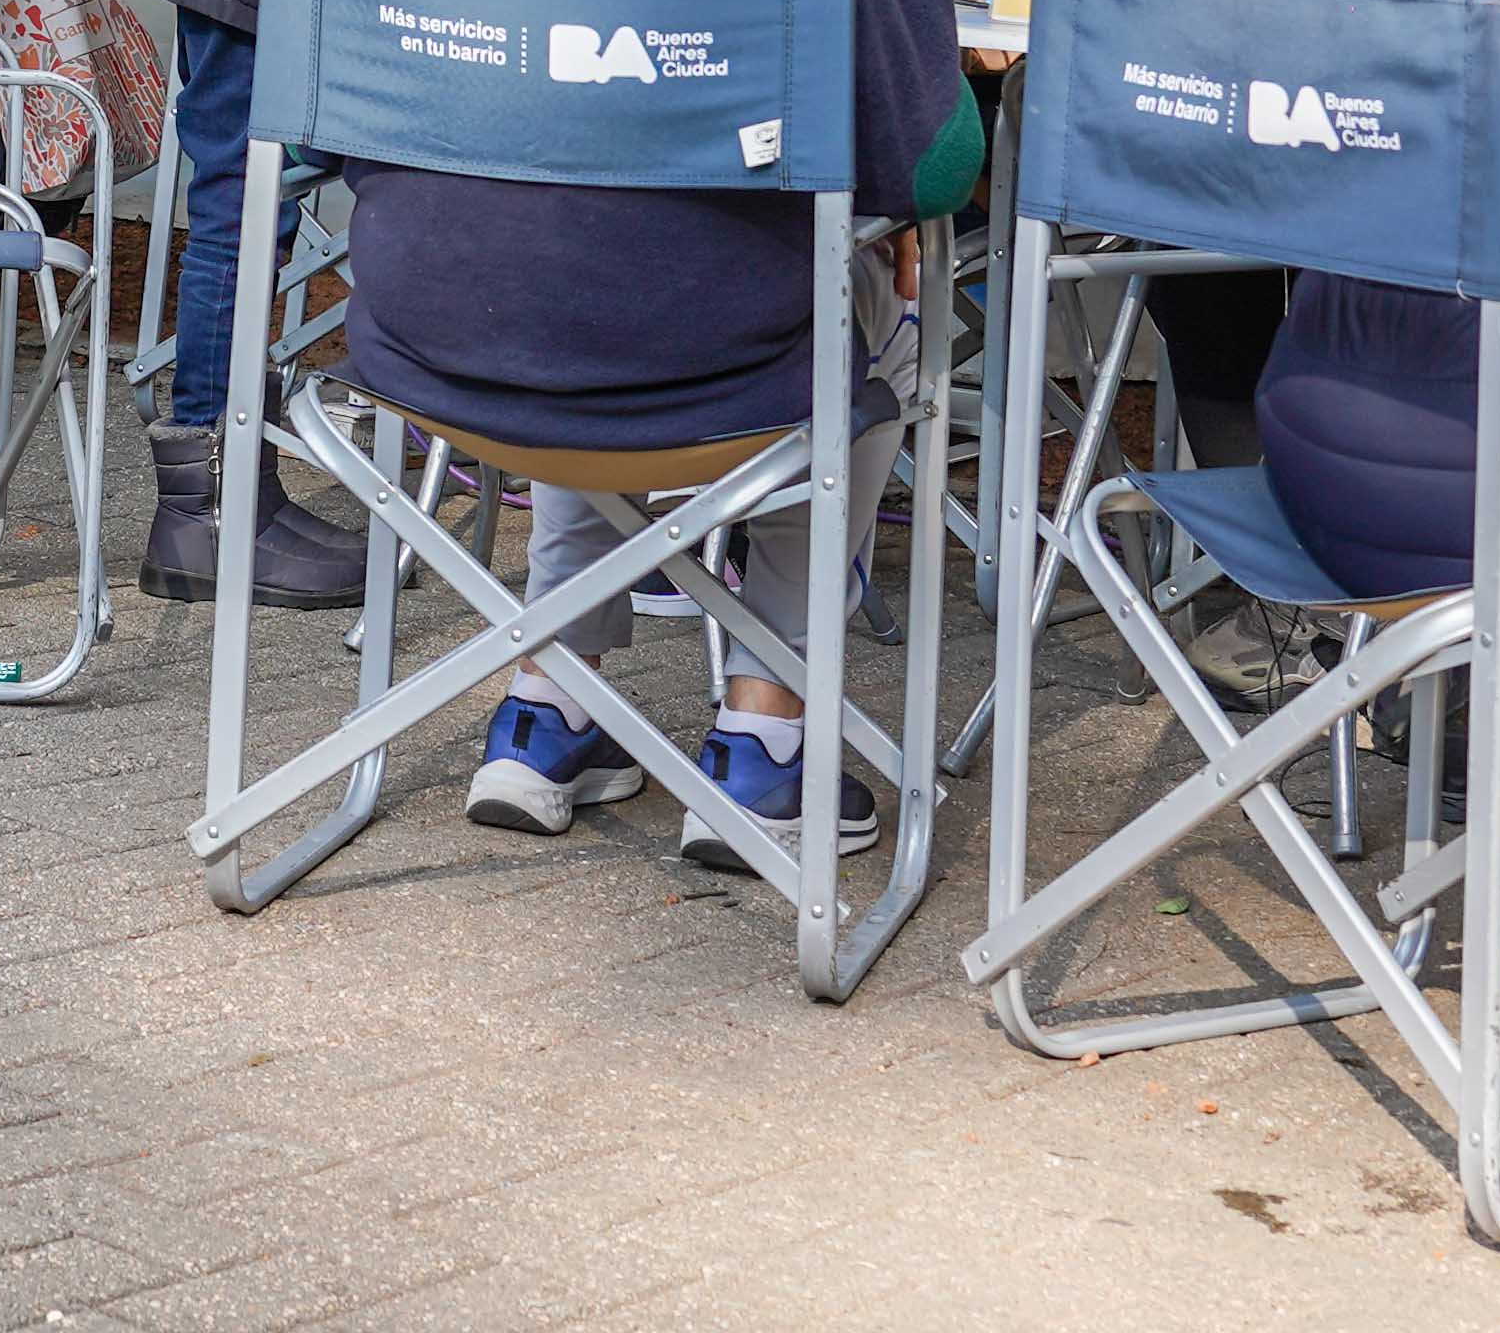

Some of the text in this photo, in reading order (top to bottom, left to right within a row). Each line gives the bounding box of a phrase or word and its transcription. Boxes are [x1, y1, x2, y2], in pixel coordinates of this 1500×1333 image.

[379, 5, 507, 42] Más servicios
[646, 30, 714, 46] Buenos
[401, 36, 507, 66] en tu barrio
[657, 45, 707, 62] Aires
[662, 58, 729, 78] Ciudad
[1123, 62, 1224, 100] Más servicios
[1136, 95, 1219, 126] en tu barrio
[1324, 91, 1384, 115] Buenos
[1335, 111, 1380, 131] Aires
[1341, 129, 1401, 151] Ciudad
